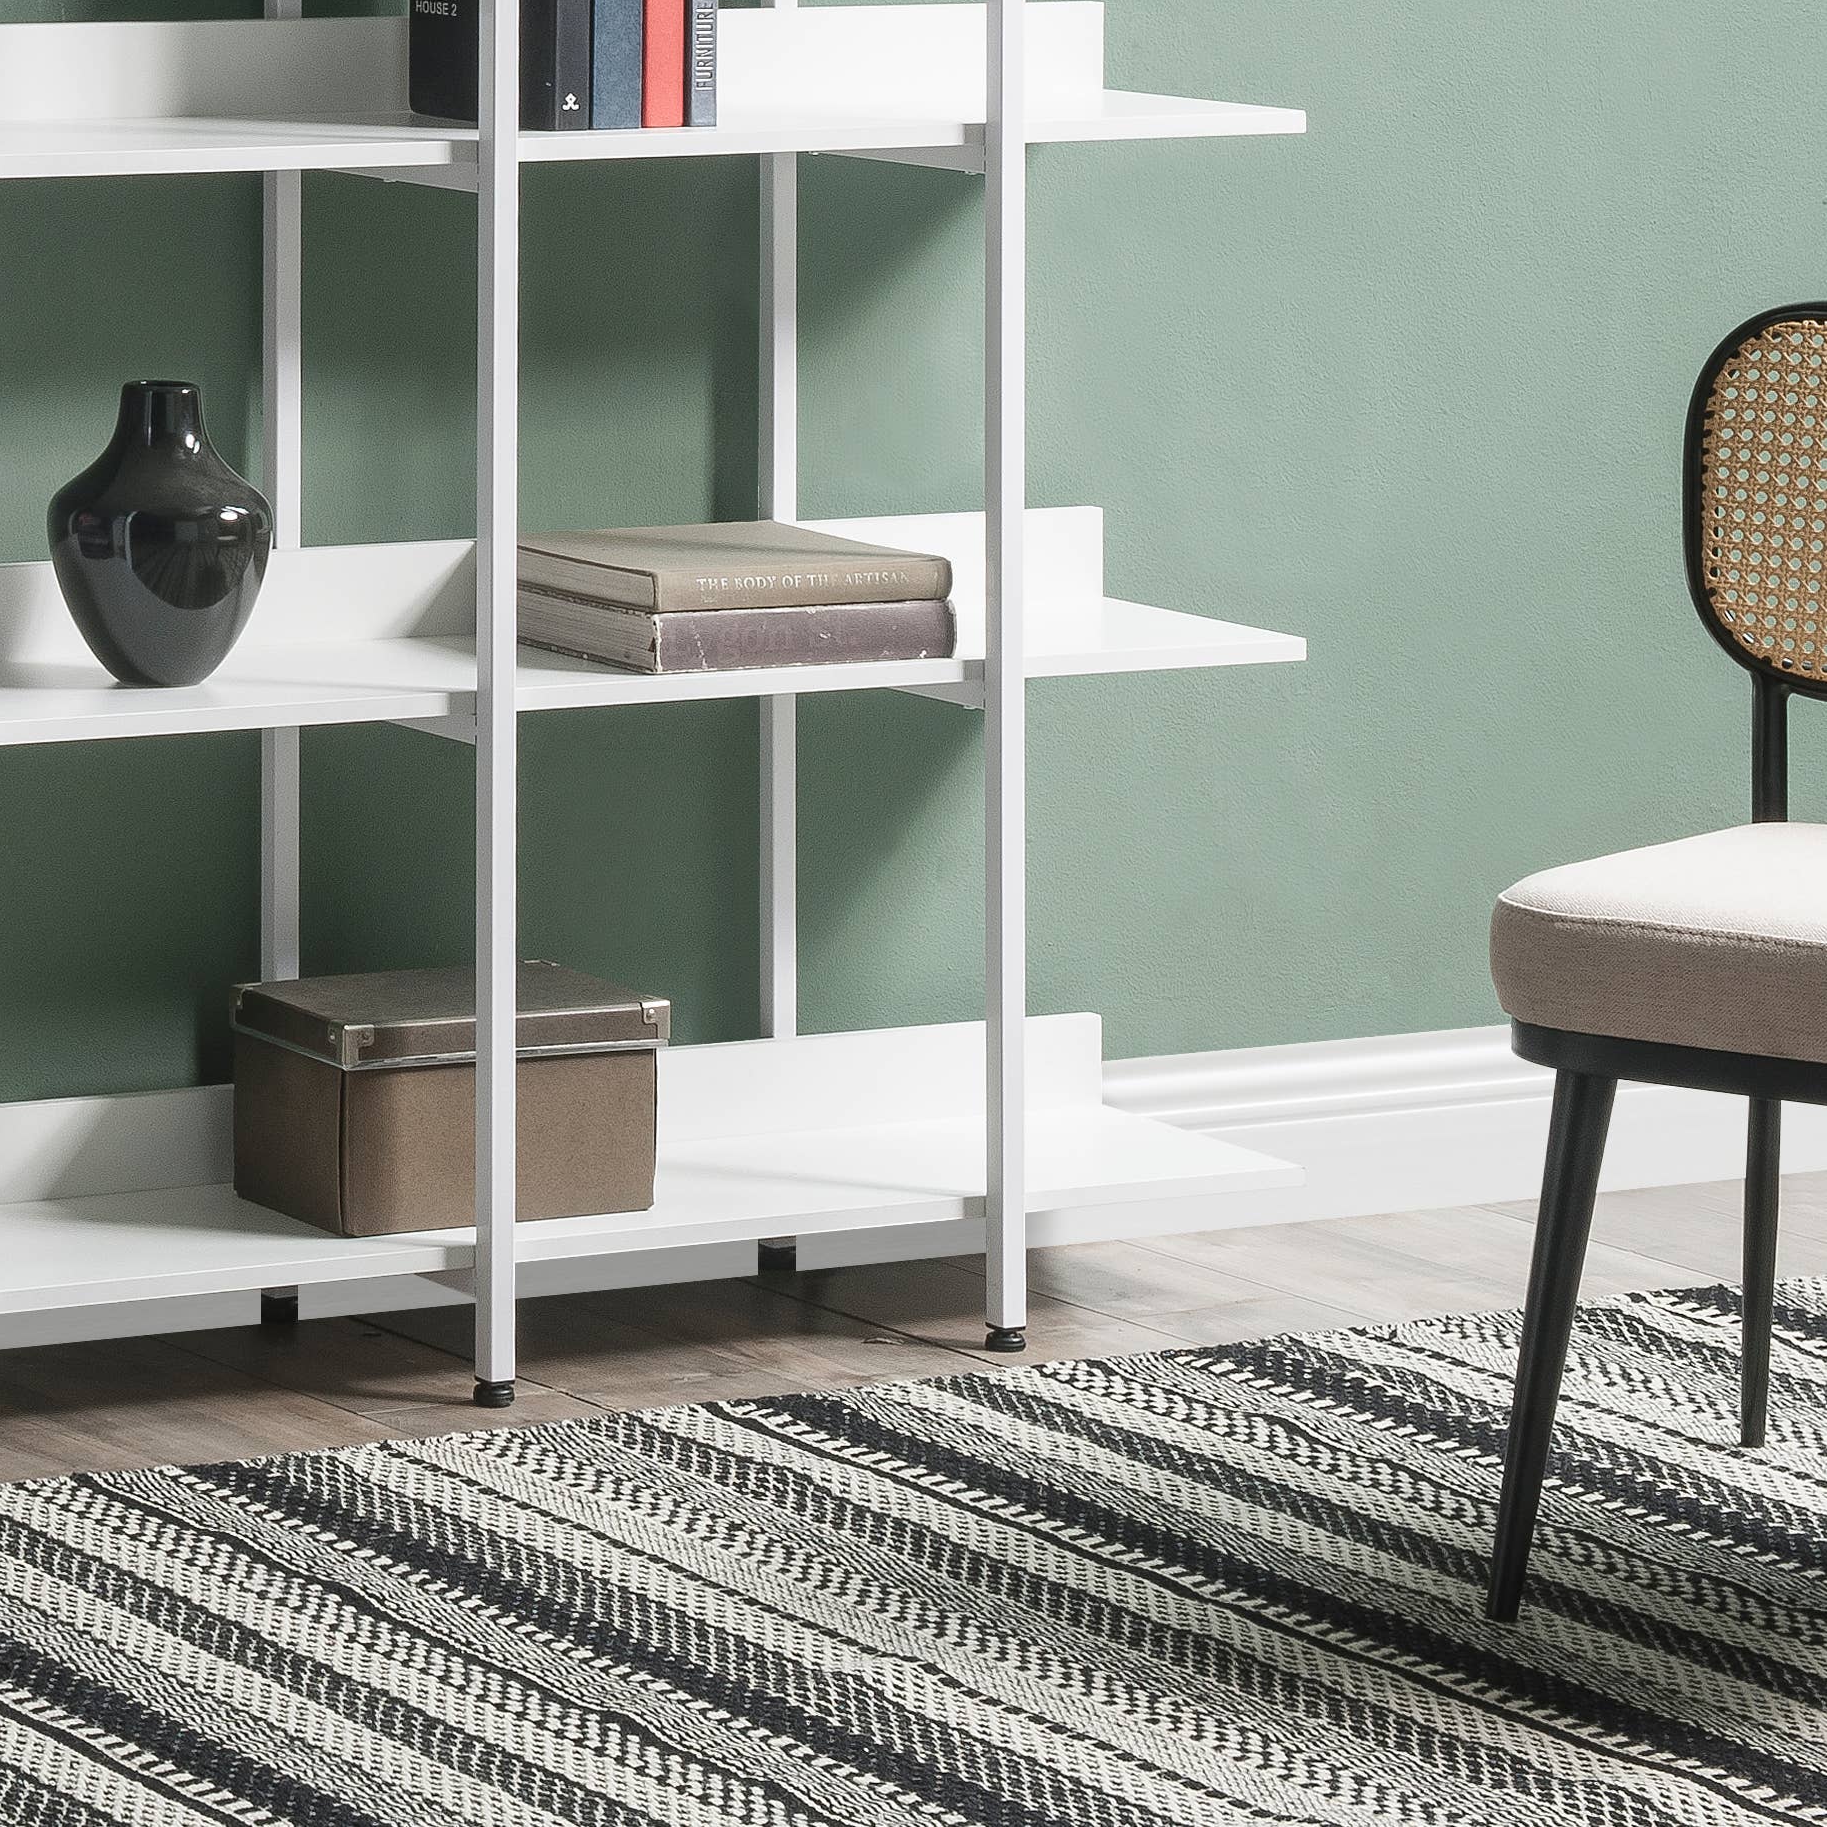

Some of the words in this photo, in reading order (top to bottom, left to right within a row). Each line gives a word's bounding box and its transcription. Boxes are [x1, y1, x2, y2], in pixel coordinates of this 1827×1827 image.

[415, 0, 449, 15] HOUSE
[450, 3, 458, 16] 2
[695, 3, 715, 91] FURNITURE
[696, 577, 728, 591] THE
[734, 576, 777, 591] BODY
[781, 575, 803, 588] OF
